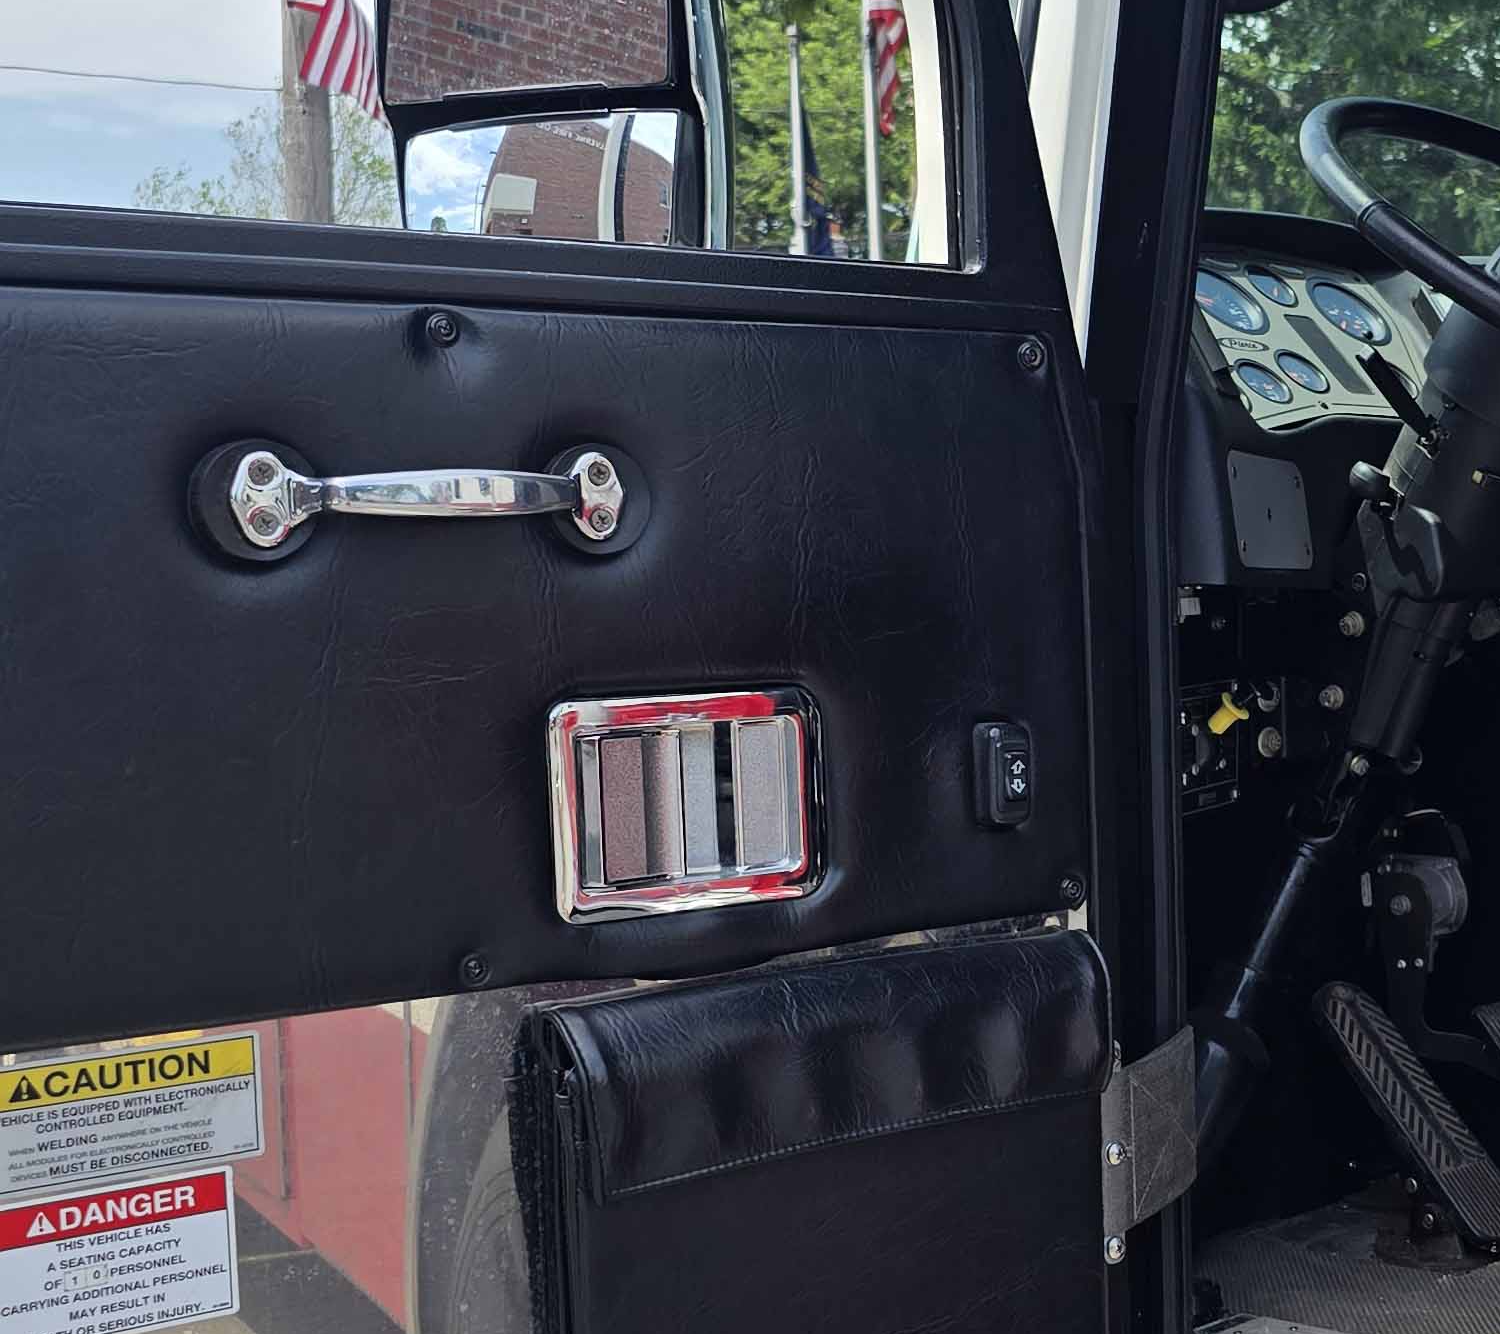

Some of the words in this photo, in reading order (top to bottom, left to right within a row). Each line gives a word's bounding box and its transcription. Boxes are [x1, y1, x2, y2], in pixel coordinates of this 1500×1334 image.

[43, 1050, 211, 1098] CAUTION
[0, 1107, 48, 1127] EHICLE
[47, 1109, 58, 1121] IS
[61, 1101, 120, 1118] EQUIPPED
[123, 1093, 152, 1110] WITH
[155, 1080, 250, 1104] ELECTRONICALLY
[35, 1113, 115, 1134] CONTROLLED
[118, 1103, 189, 1122] EQUIPMENT.
[8, 1162, 24, 1171] ALL
[26, 1154, 68, 1167] MODULES
[70, 1151, 88, 1161] FOR
[89, 1138, 160, 1156] ELECTRONICALLY
[161, 1131, 215, 1145] CONTROLLED
[37, 1134, 98, 1152] WELDING
[101, 1128, 147, 1142] ANYWHERE
[149, 1124, 161, 1134] ON
[164, 1122, 179, 1132] THE
[180, 1118, 212, 1130] VEHICLE
[49, 1161, 87, 1176] MUST
[89, 1158, 107, 1170] BE
[110, 1141, 213, 1166] DISCONNECTED.
[58, 1185, 195, 1232] DANGER
[47, 1262, 57, 1272] A
[59, 1251, 115, 1270] SEATING
[119, 1238, 181, 1258] CAPACITY
[56, 1239, 85, 1253] THIS
[88, 1229, 142, 1247] VEHICLE
[145, 1223, 171, 1236] HAS
[1, 1294, 70, 1317] CARRYING
[73, 1279, 150, 1303] ADDITIONAL
[153, 1263, 227, 1287] PERSONNEL
[44, 1279, 63, 1291] OF
[110, 1254, 187, 1277] PERSONNEL
[69, 1307, 97, 1322] MAY
[100, 1295, 149, 1315] RESULT
[153, 1292, 166, 1304] IN
[98, 1312, 154, 1334] SERIOUS
[156, 1301, 206, 1319] INJURY.
